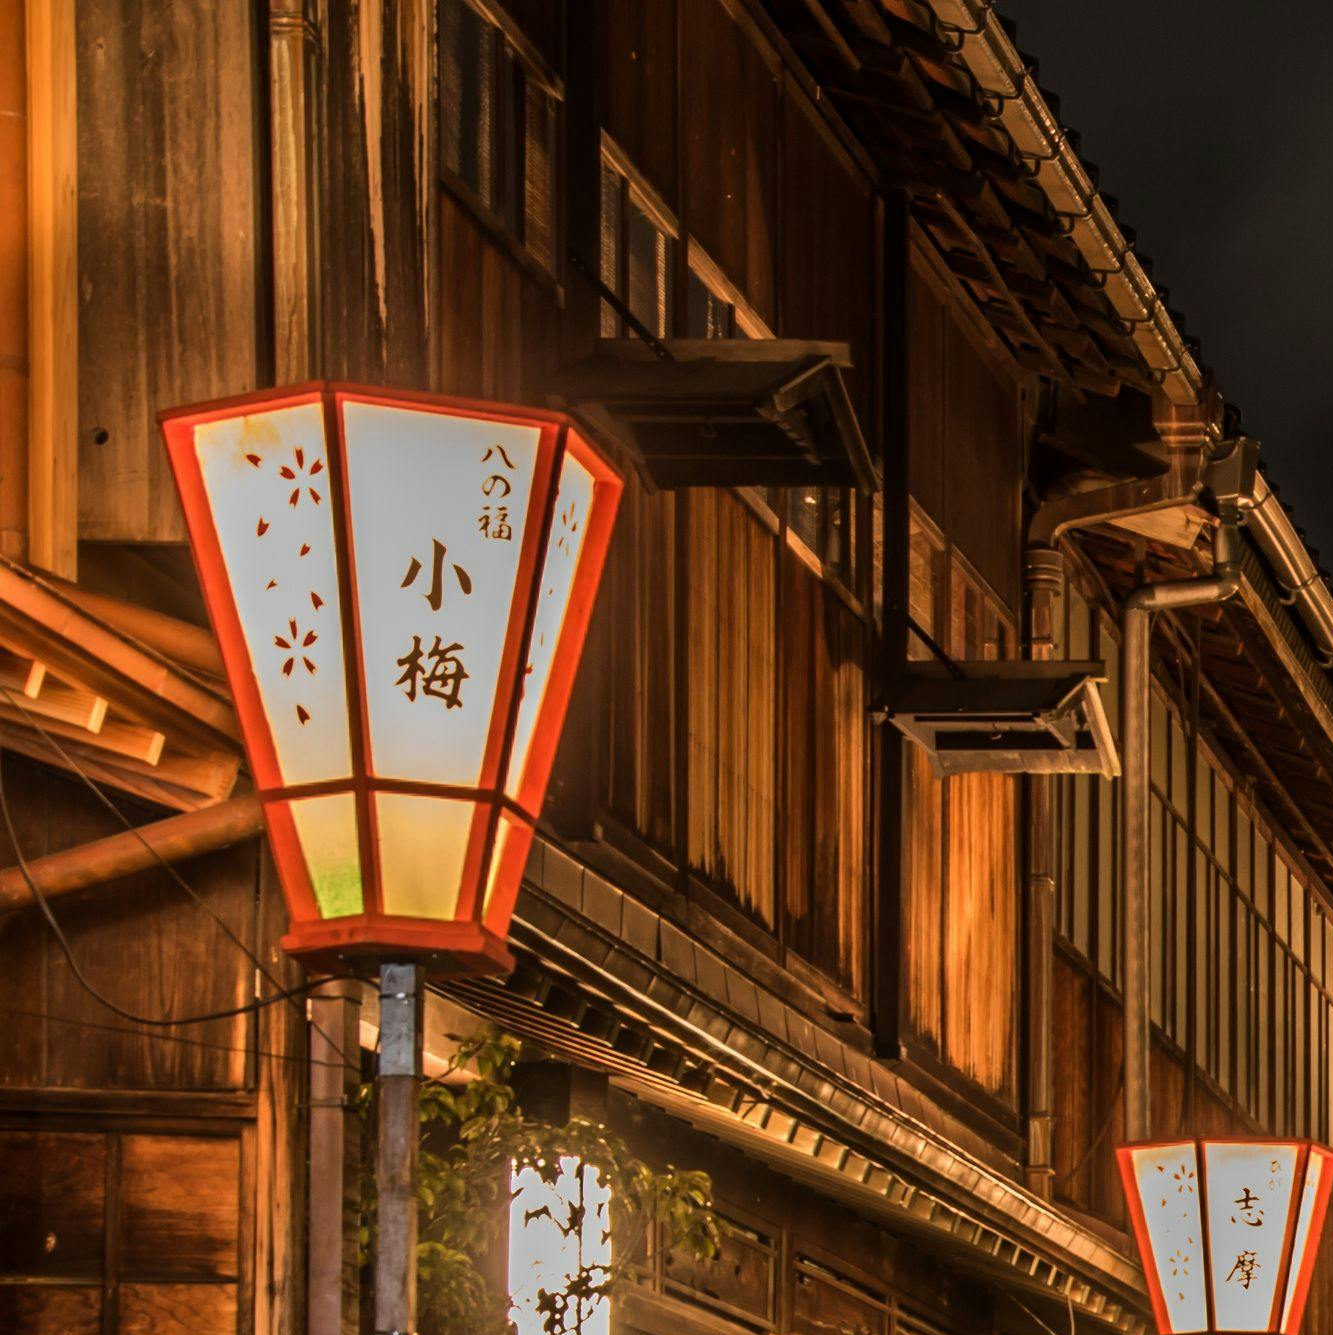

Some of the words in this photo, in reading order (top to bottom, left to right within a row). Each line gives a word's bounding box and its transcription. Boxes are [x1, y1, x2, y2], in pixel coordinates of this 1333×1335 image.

[479, 445, 515, 539] 八の福
[396, 538, 472, 709] 小梅
[1226, 1187, 1264, 1289] 志摩
